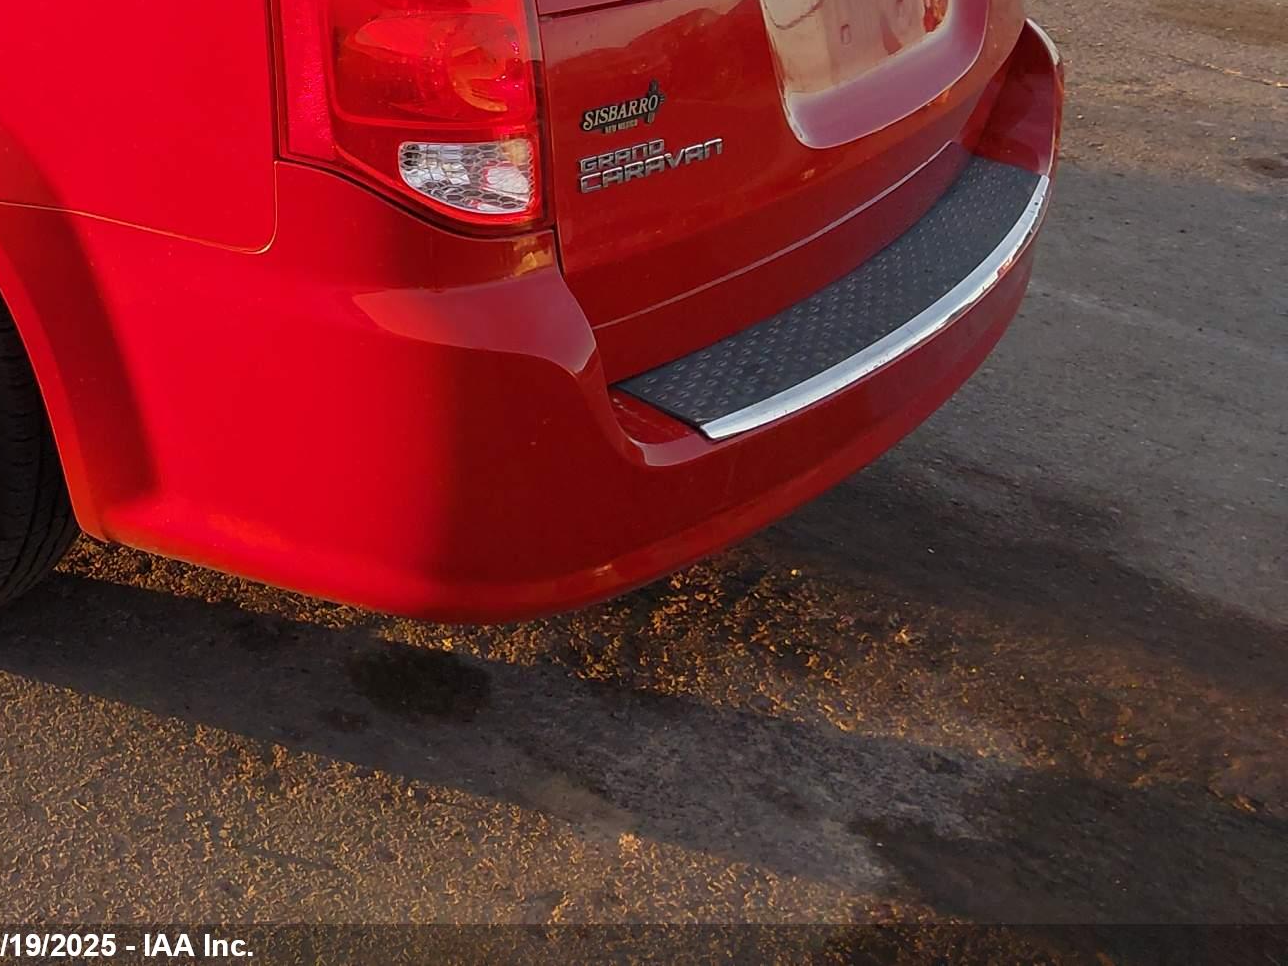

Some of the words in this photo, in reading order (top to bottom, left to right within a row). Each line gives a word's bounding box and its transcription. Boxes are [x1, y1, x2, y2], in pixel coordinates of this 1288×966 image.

[582, 94, 659, 131] SISBARRO
[580, 139, 664, 173] GRAND
[580, 138, 723, 194] CARAVAN
